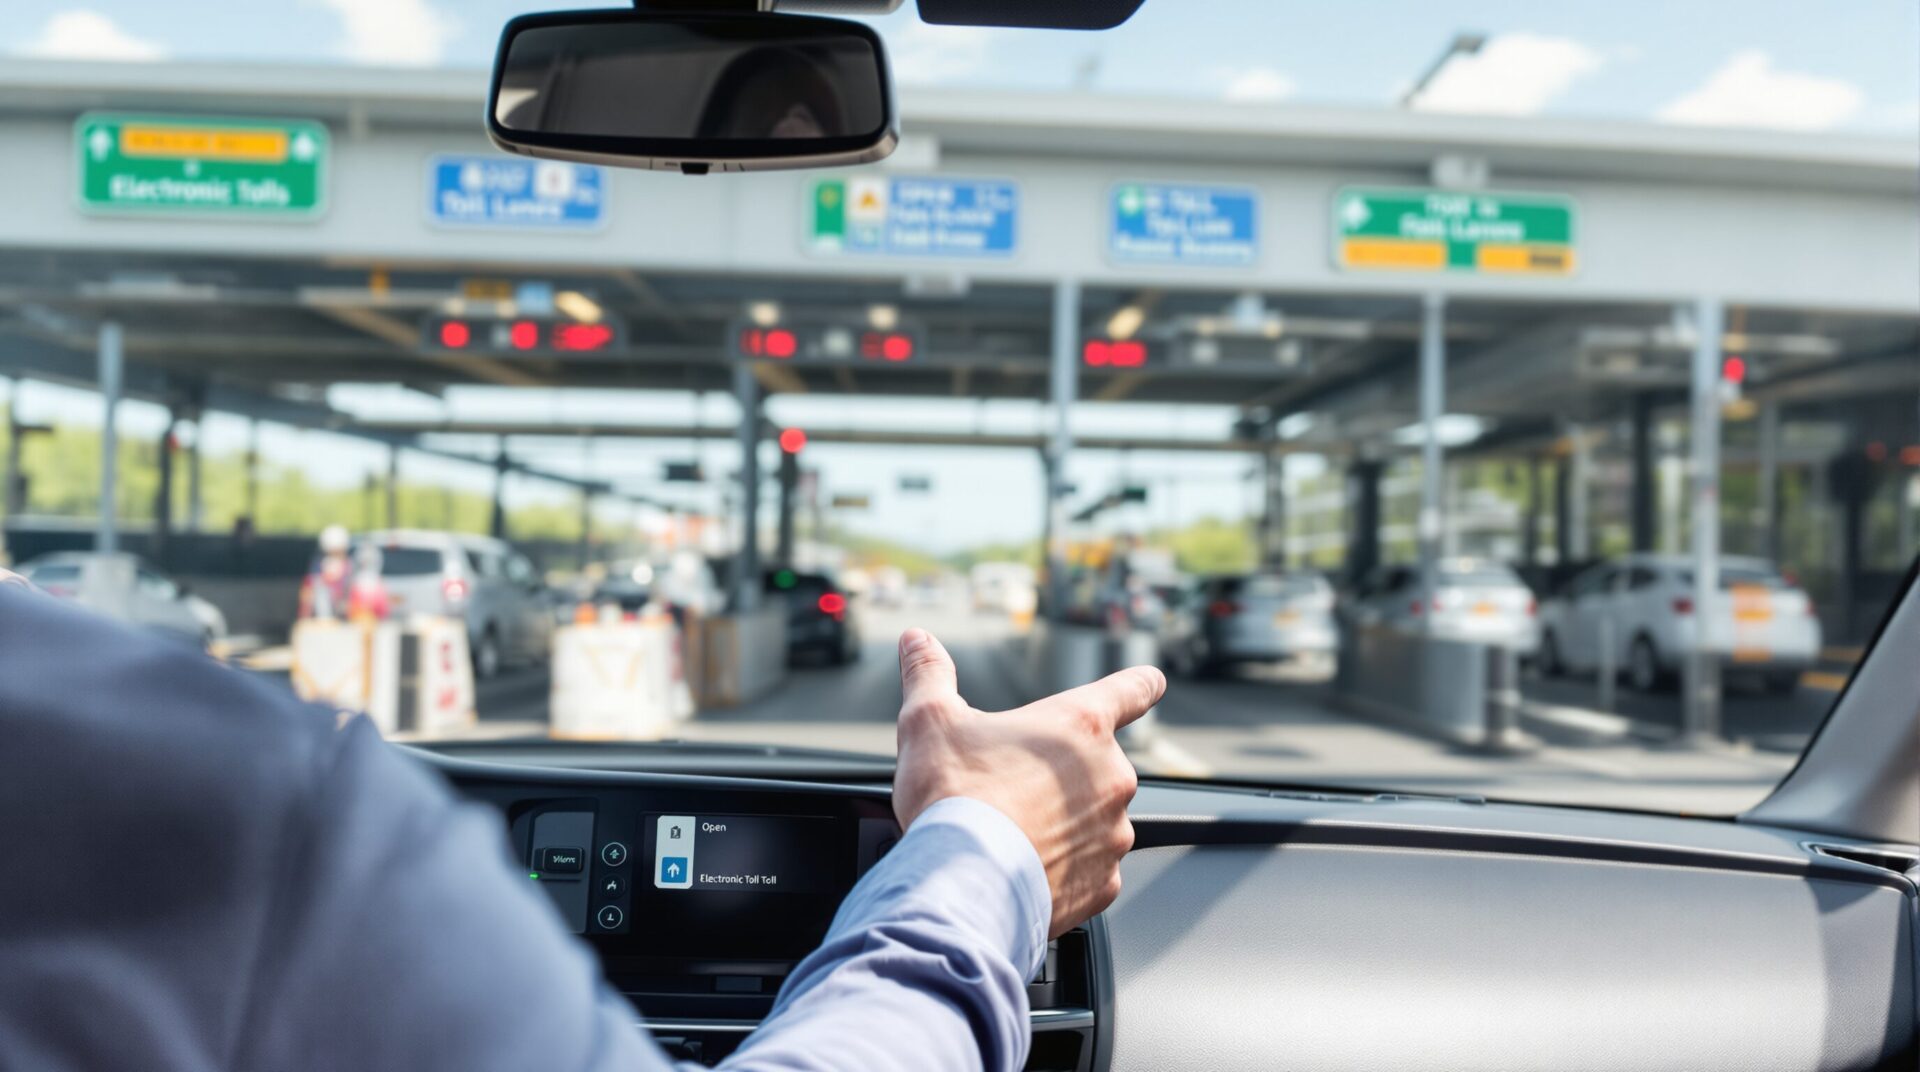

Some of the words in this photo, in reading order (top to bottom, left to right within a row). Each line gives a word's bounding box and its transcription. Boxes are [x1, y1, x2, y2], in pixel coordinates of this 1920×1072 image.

[701, 822, 727, 833] Open
[700, 873, 743, 884] Electronic
[744, 874, 760, 884] Toll
[761, 875, 777, 885] Toll
